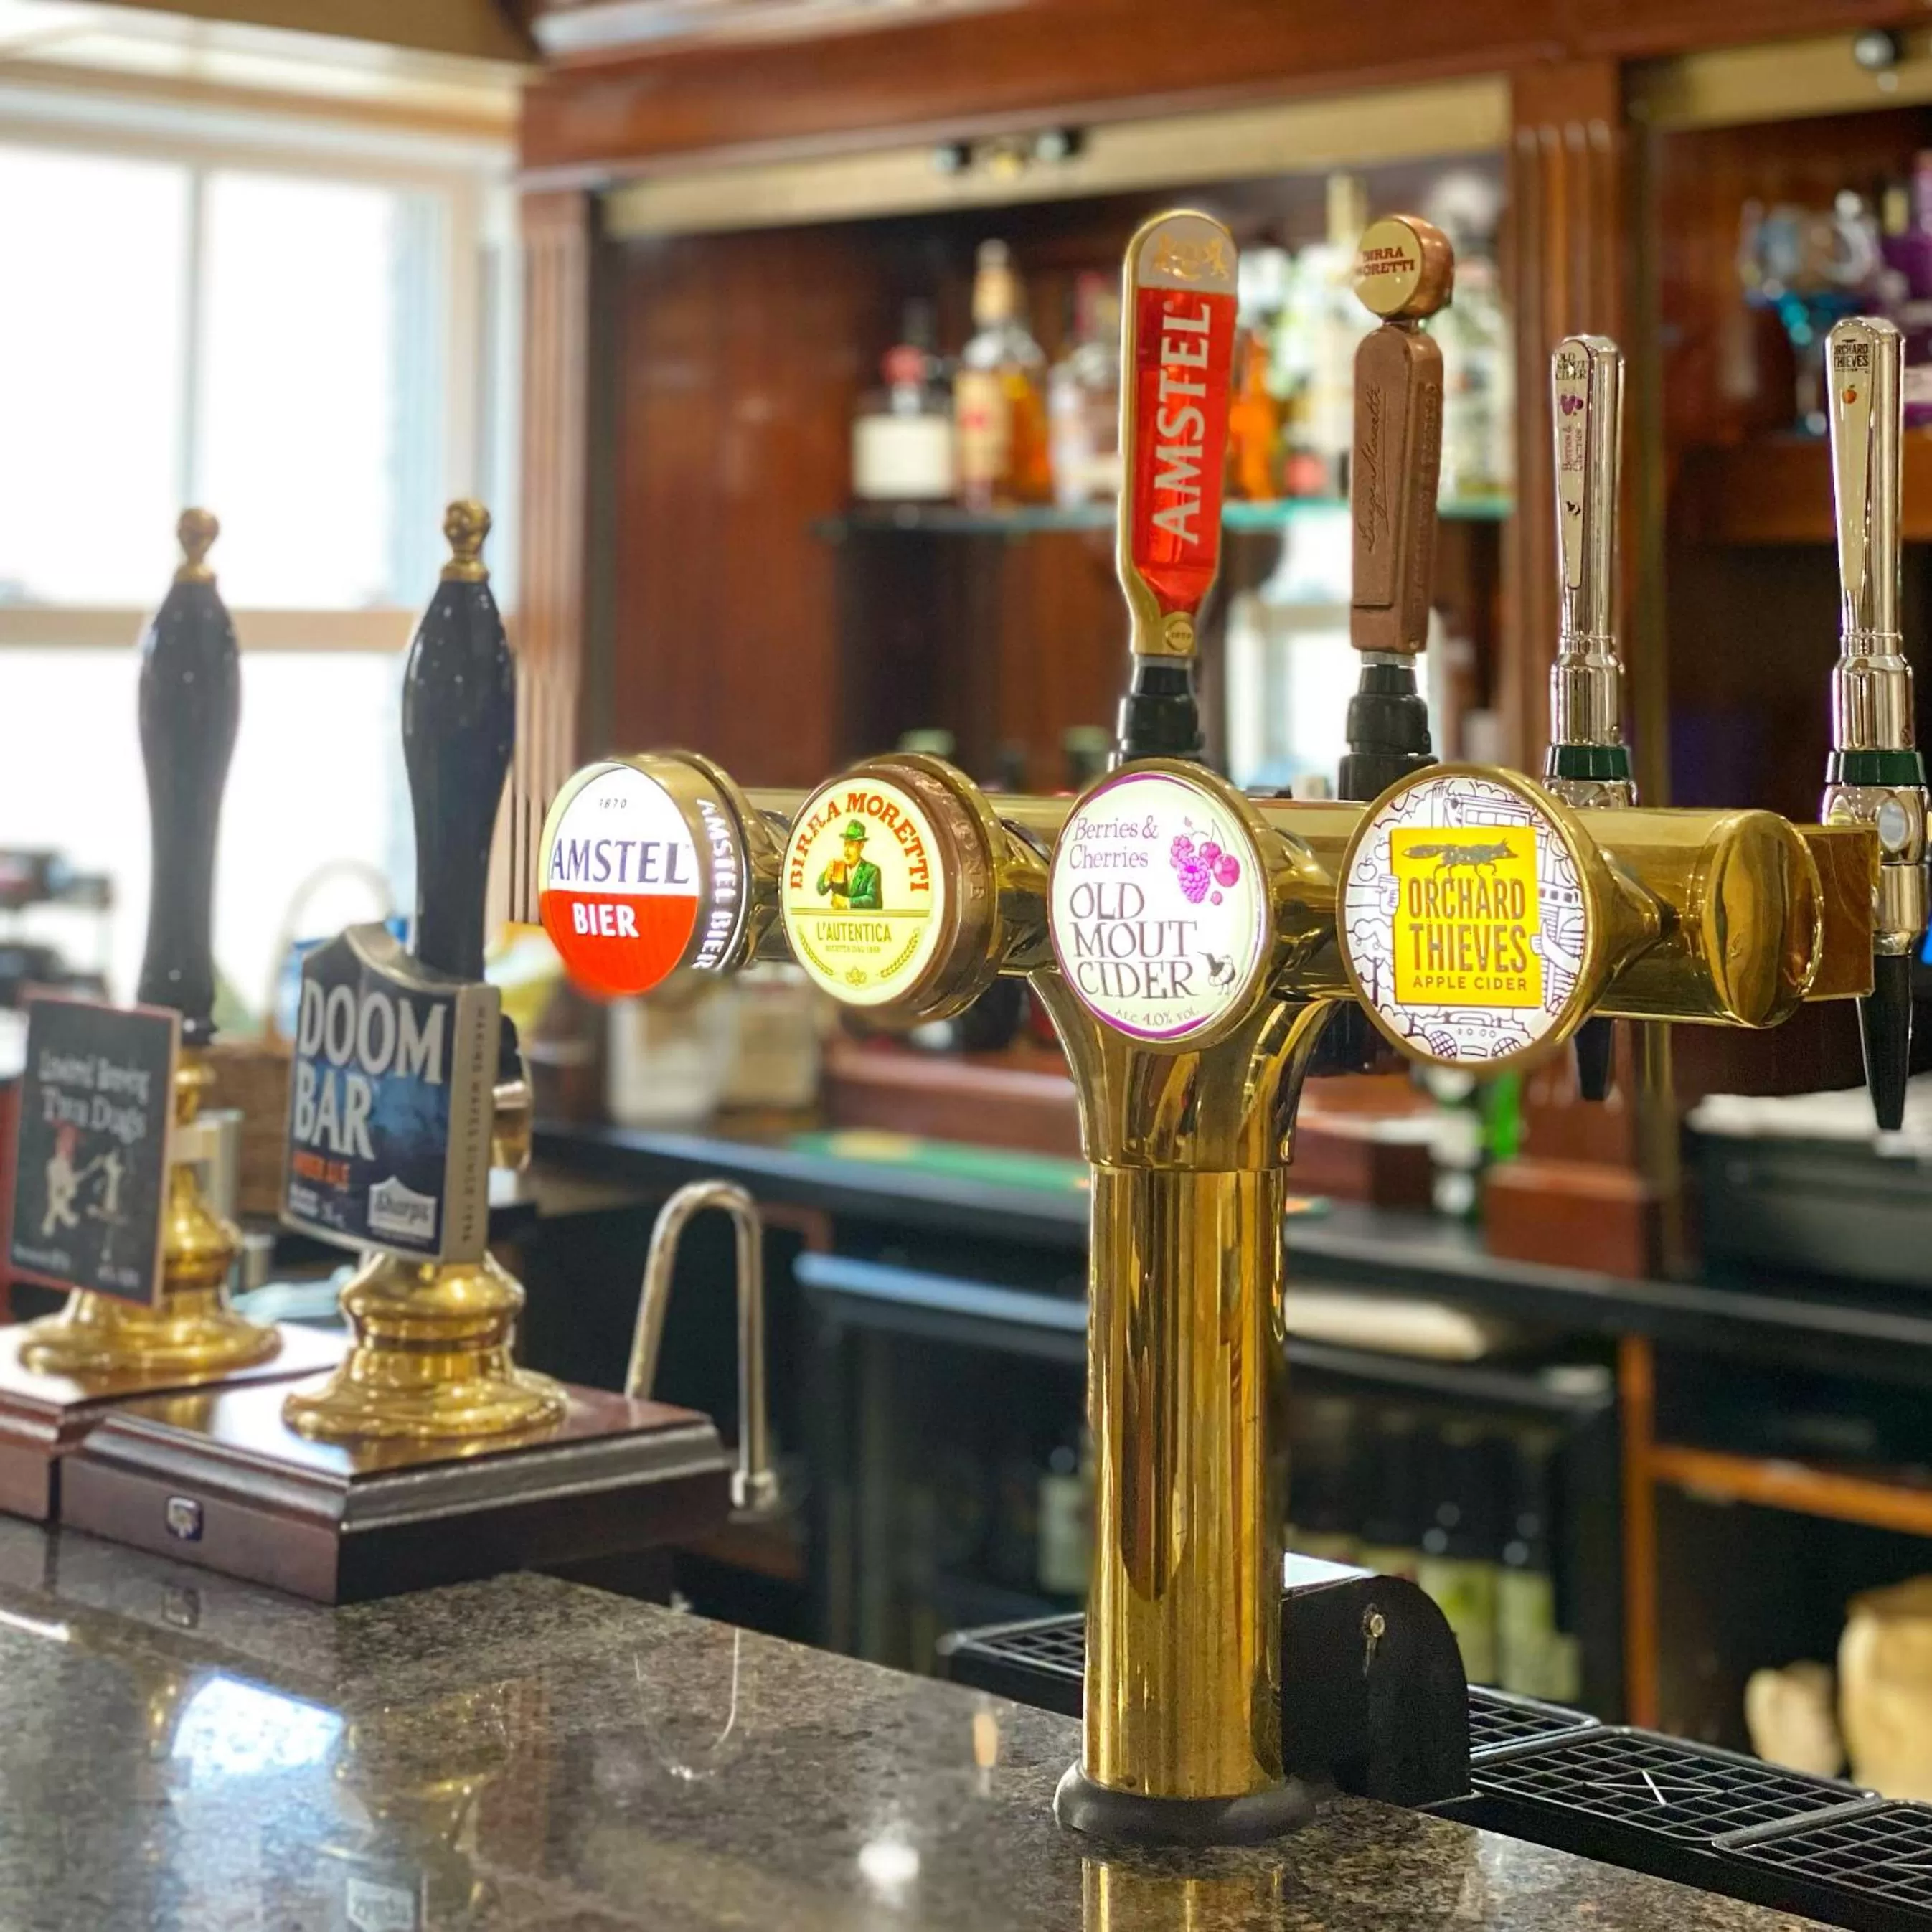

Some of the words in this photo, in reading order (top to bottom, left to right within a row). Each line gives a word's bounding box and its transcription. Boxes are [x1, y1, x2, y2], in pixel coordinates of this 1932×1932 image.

[1152, 303, 1212, 547] AMSTEL
[791, 800, 842, 890] BIRRA
[846, 793, 930, 892] MORETTI
[1073, 817, 1139, 842] Berries
[1142, 815, 1160, 839] &
[551, 839, 689, 884] AMSTEL
[696, 798, 737, 903] AMSTEL
[1070, 844, 1149, 869] Cherries
[572, 902, 640, 938] BIER
[1069, 882, 1145, 920] OLD
[1408, 877, 1526, 920] ORCHARD
[690, 911, 734, 969] BIER
[817, 921, 892, 943] L'AUTENTICA
[1069, 920, 1197, 959] MOUT
[1409, 923, 1527, 974] THIEVES
[1077, 960, 1200, 999] CIDER
[1413, 976, 1466, 989] APPLE
[1474, 976, 1527, 991] CIDER
[298, 978, 447, 1085] DOOM
[293, 1058, 376, 1162] BAR
